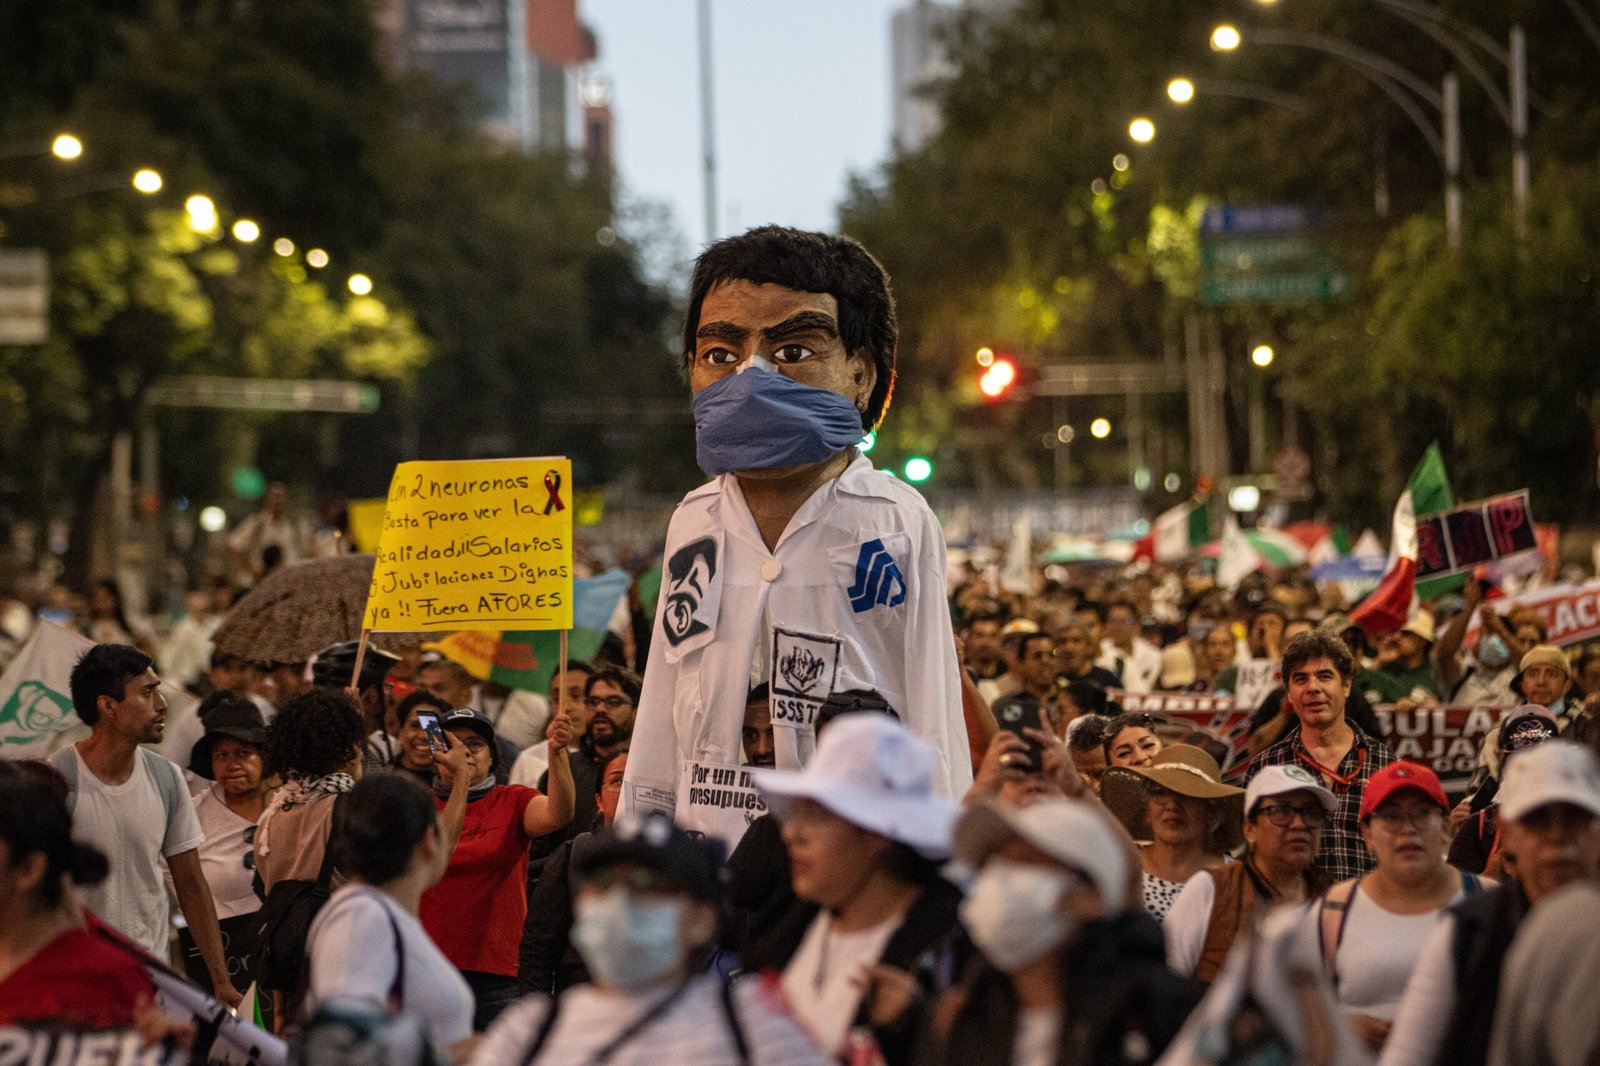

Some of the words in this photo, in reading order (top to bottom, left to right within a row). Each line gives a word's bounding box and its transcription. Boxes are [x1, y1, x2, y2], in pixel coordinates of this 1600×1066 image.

[410, 473, 426, 500] 2
[430, 475, 529, 498] neuronas
[473, 507, 503, 520] ver
[513, 498, 541, 516] la
[382, 570, 494, 594] Jubilaciones
[415, 598, 469, 617] Fuera
[477, 592, 562, 614] AFORES
[712, 768, 736, 787] un
